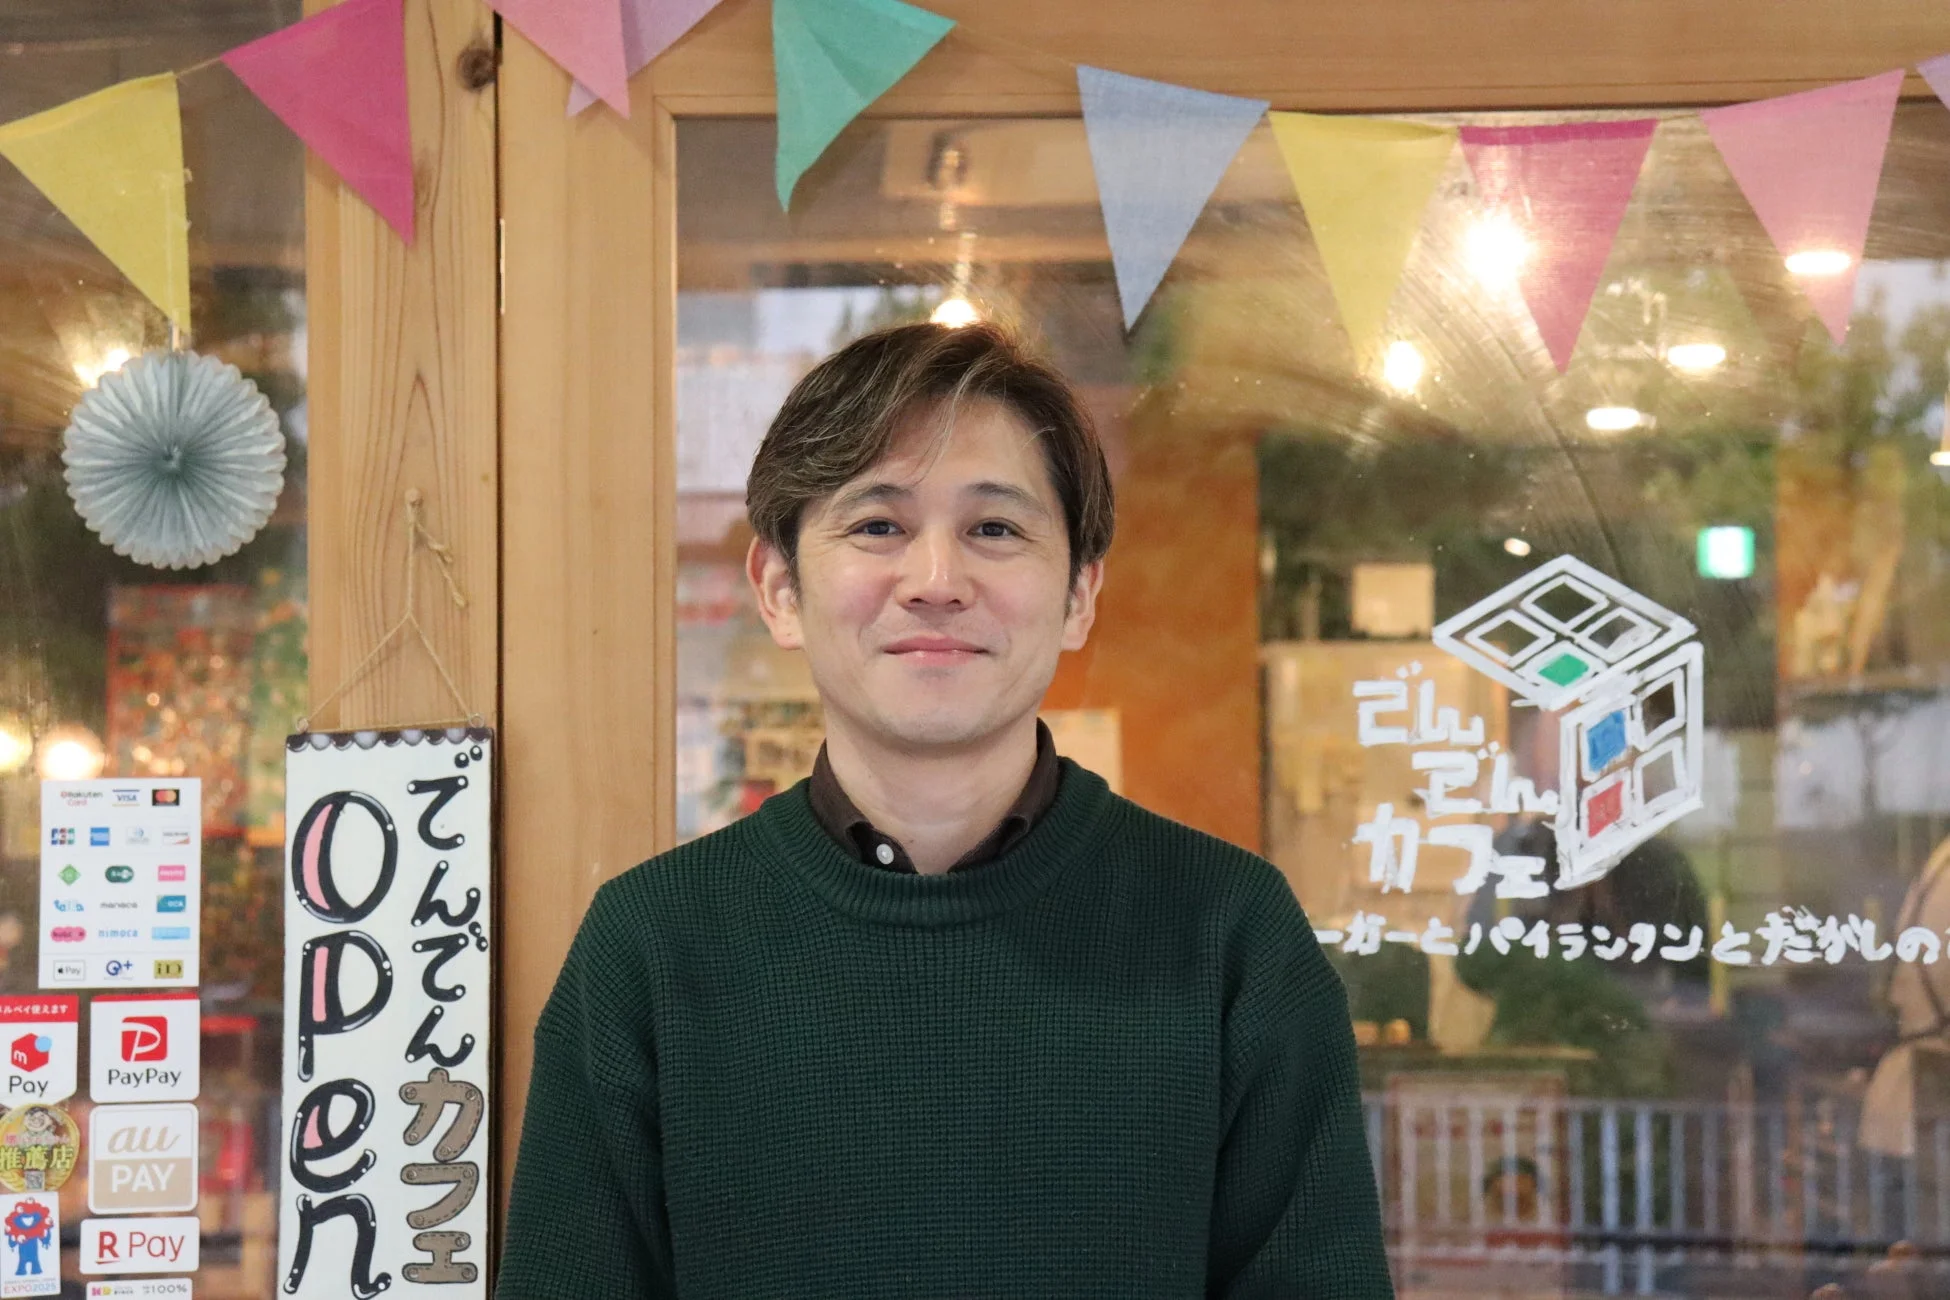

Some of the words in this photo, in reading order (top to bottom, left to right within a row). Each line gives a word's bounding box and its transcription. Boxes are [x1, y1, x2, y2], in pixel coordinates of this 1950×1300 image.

[1352, 803, 1549, 899] カフェ
[98, 929, 138, 938] nimoca
[1306, 905, 1950, 965] ーガーとパイランタンとだがしの
[9, 1075, 49, 1098] Pay
[107, 1068, 182, 1089] PayPay
[107, 1125, 181, 1154] au
[111, 1163, 177, 1193] PAY
[128, 1231, 186, 1262] Pay
